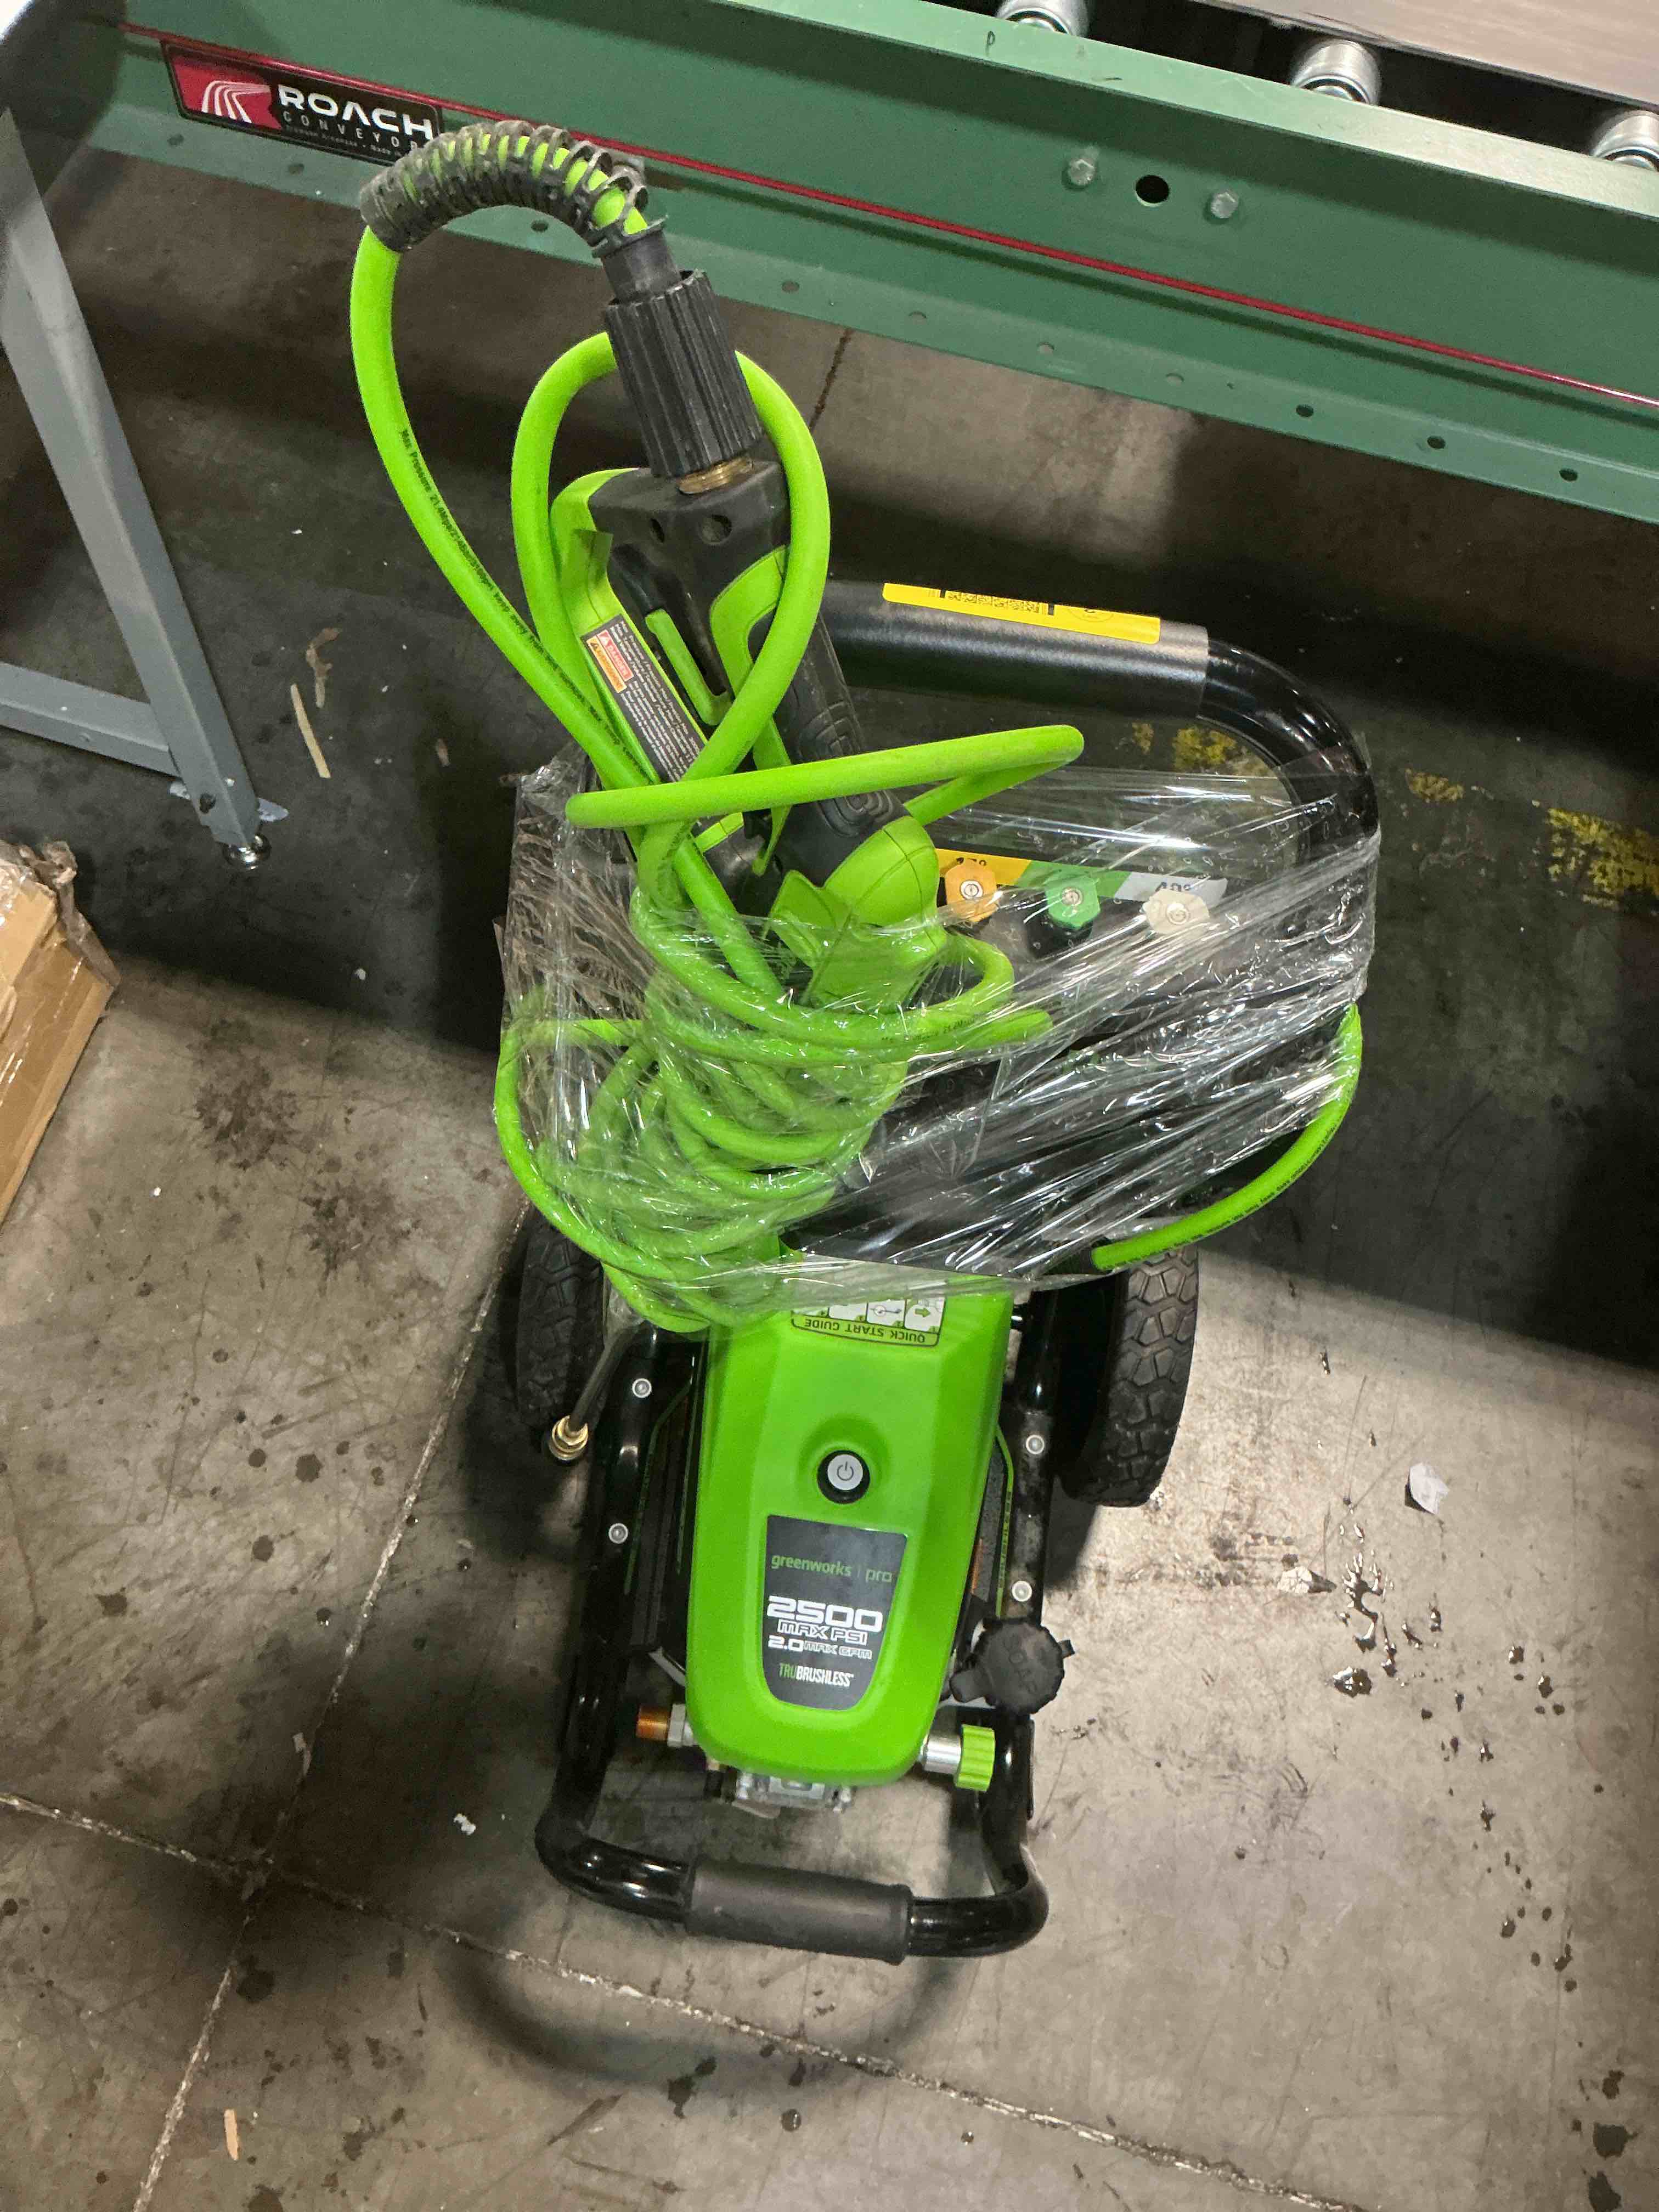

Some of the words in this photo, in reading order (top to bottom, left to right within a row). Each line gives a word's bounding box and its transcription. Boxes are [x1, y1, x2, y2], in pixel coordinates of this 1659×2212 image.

[278, 85, 433, 140] ROACH
[805, 1318, 840, 1331] GUIDE
[845, 1324, 884, 1338] START
[890, 1330, 925, 1344] QUICK
[771, 1555, 851, 1577] greenworks
[865, 1568, 893, 1583] pro
[766, 1595, 883, 1633] 2500
[777, 1619, 831, 1641] MAX
[831, 1627, 868, 1646] PSI
[768, 1635, 804, 1652] 2.0
[804, 1640, 838, 1655] MAX
[838, 1646, 872, 1660] GPM
